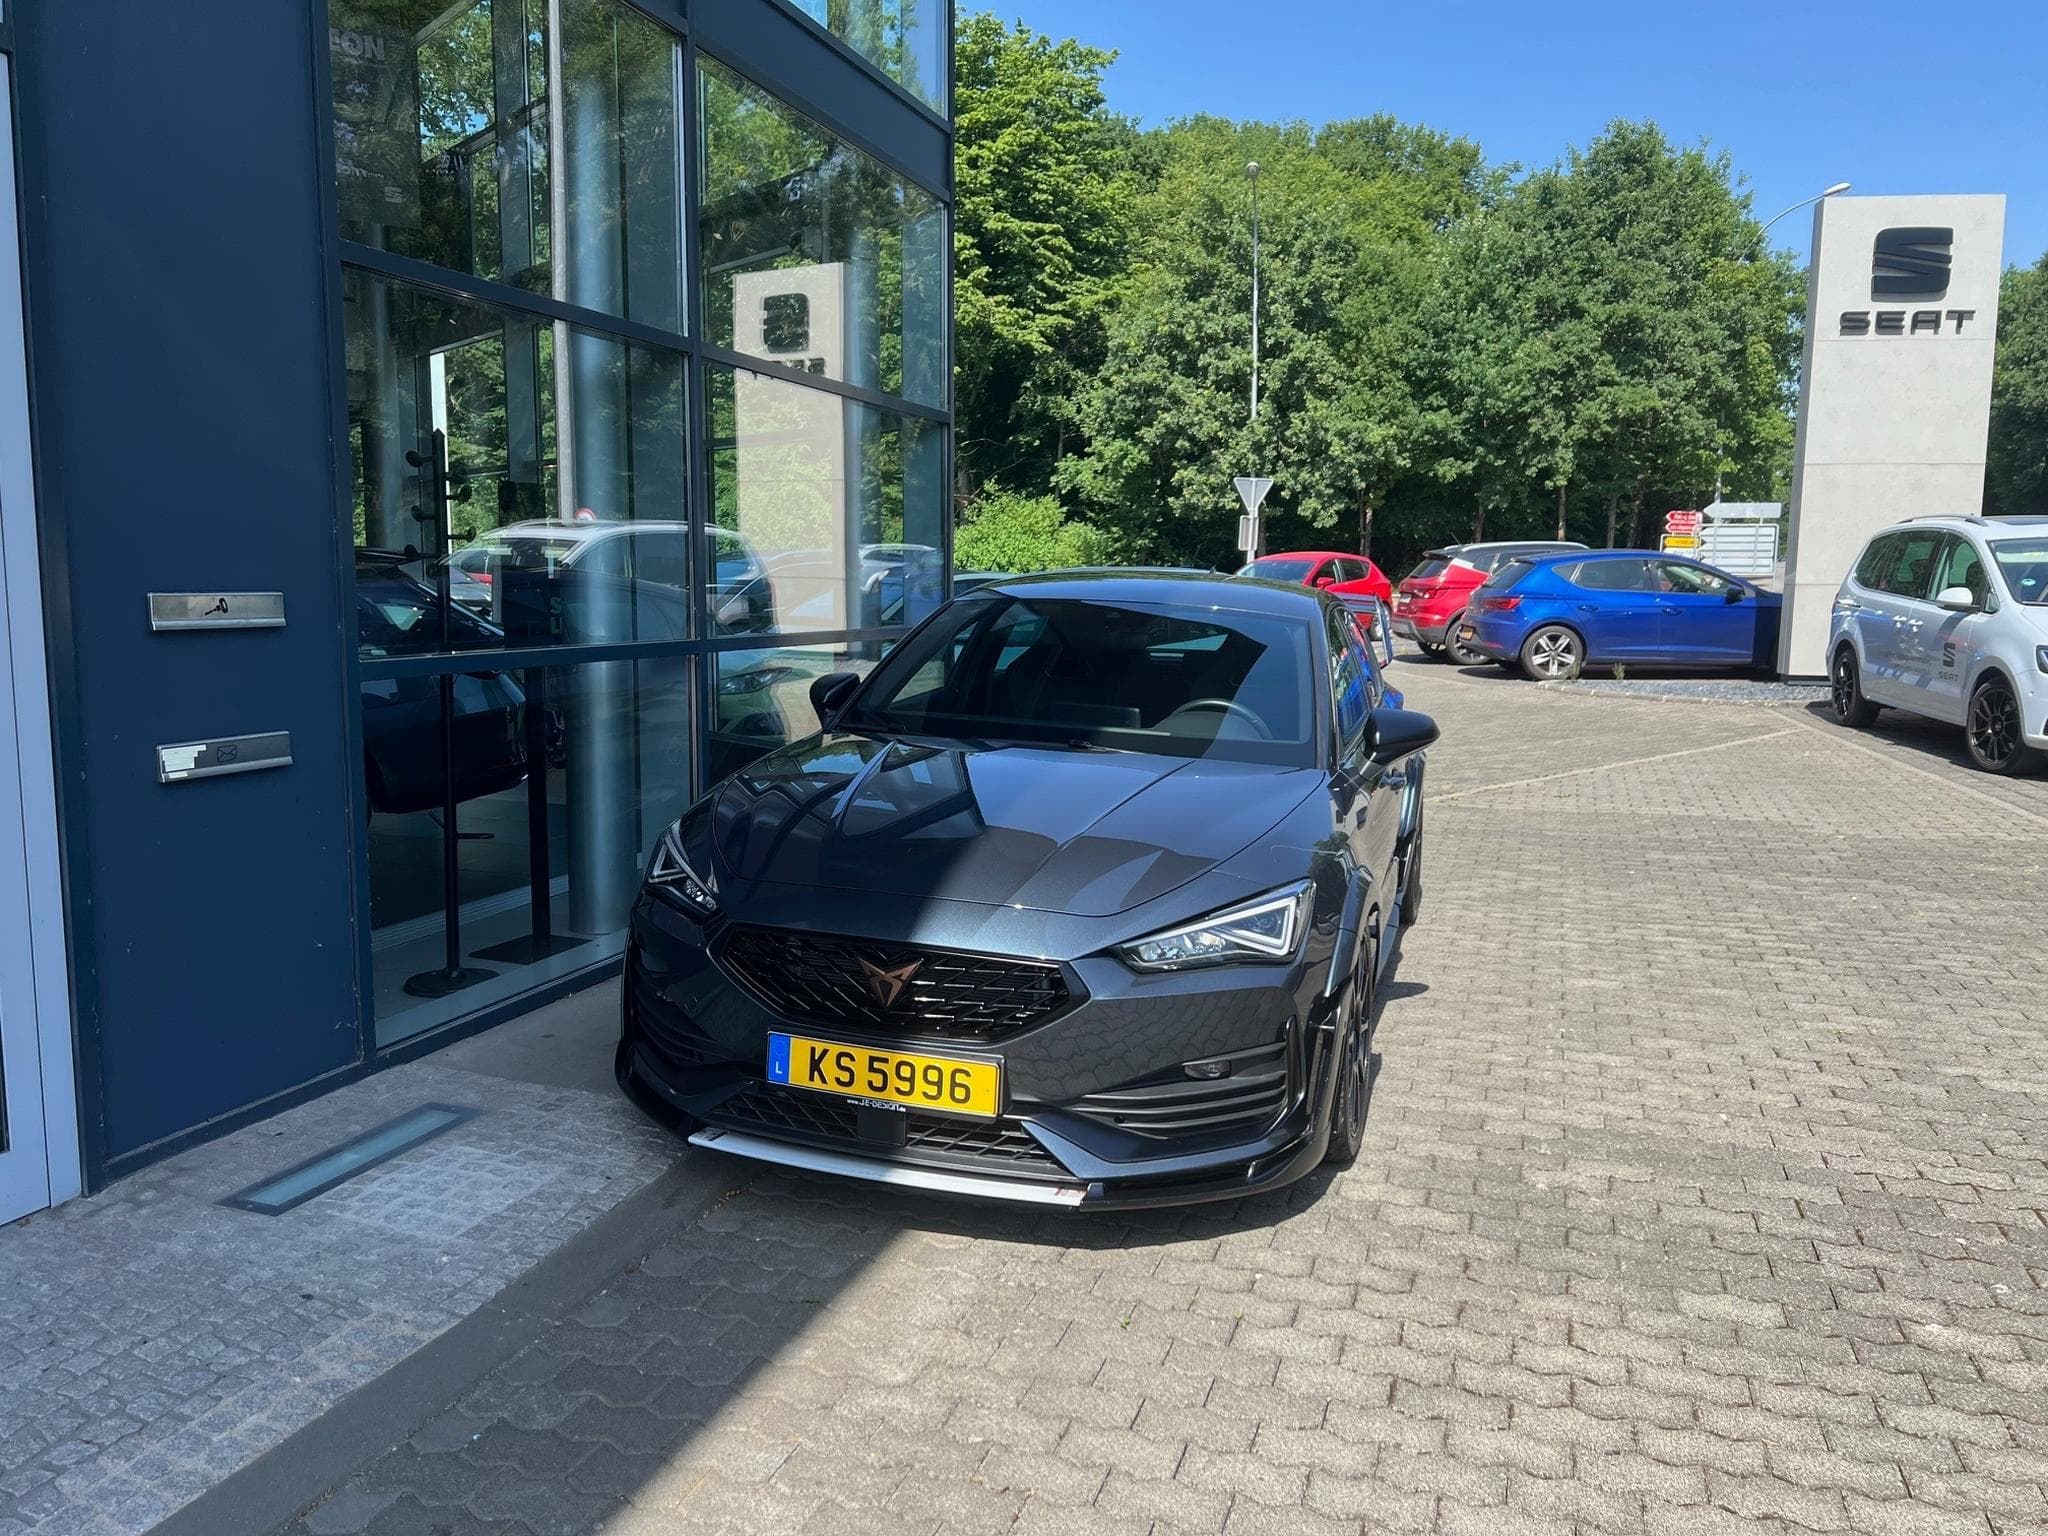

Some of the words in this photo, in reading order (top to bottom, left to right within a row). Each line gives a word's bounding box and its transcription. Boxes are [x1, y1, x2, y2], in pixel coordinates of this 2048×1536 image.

[1839, 310, 1977, 336] SEAT
[1937, 671, 1959, 681] SEAT
[775, 1061, 783, 1075] L
[808, 1046, 856, 1088] KS
[867, 1055, 972, 1105] 5996
